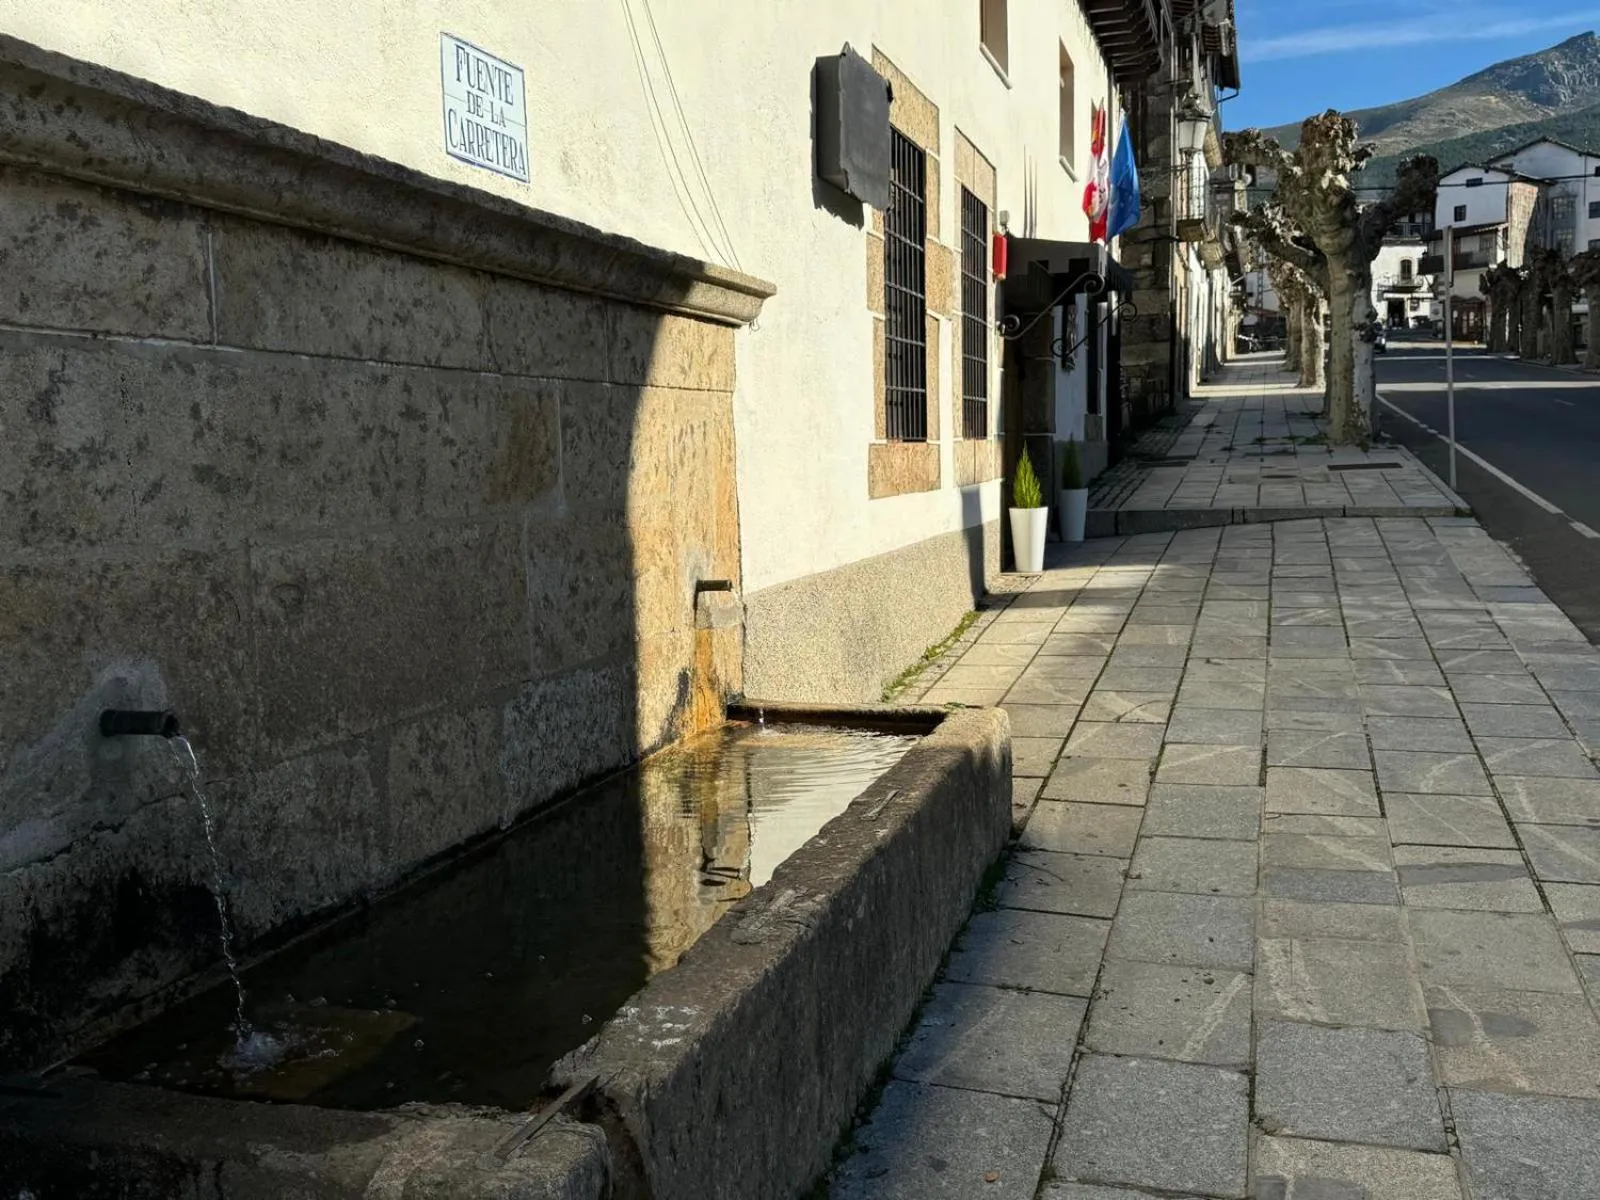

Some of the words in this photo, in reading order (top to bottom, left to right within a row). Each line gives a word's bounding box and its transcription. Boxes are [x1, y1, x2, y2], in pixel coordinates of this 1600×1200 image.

[455, 44, 513, 106] FUENTE
[466, 90, 484, 118] DE
[490, 101, 506, 128] LA
[448, 108, 526, 175] CARRETERA
